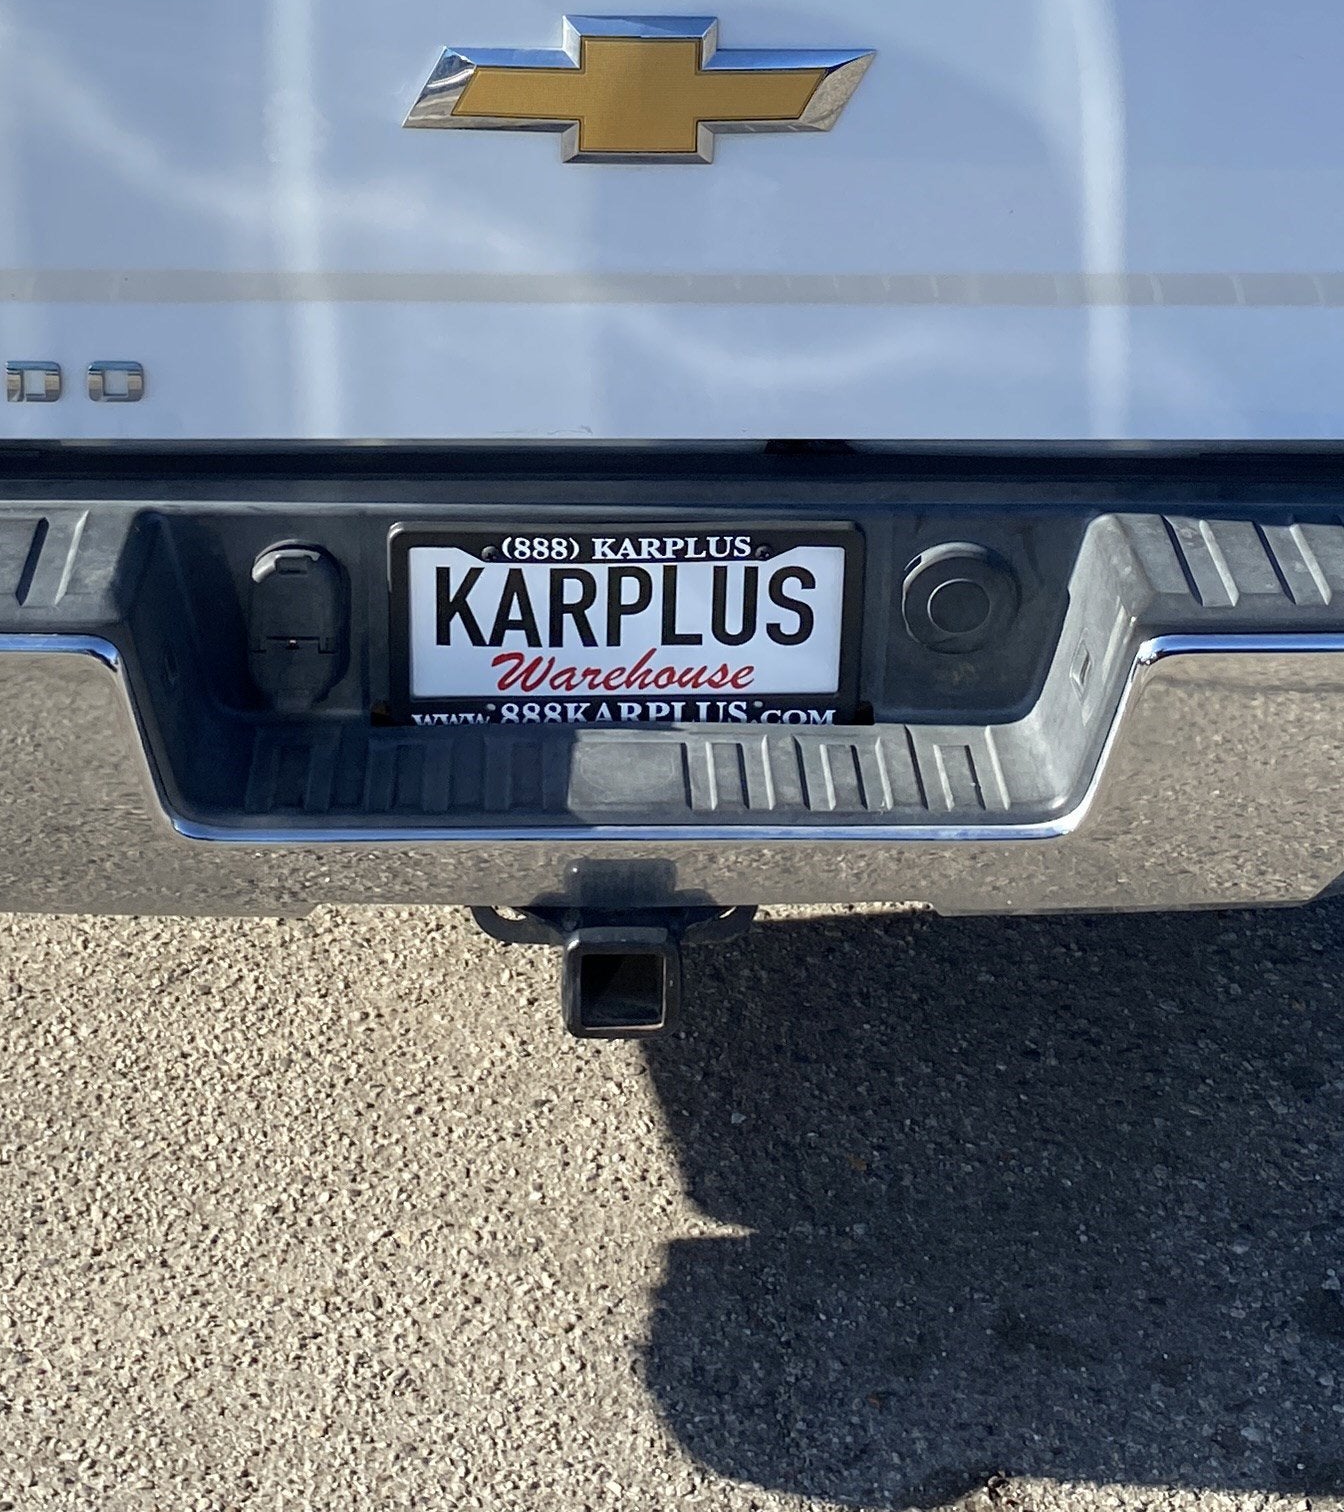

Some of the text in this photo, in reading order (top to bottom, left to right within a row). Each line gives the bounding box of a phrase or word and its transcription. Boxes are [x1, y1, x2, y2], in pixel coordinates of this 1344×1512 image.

[501, 535, 752, 561] (888) KARPLUS
[435, 565, 817, 649] KARPLUS
[491, 648, 756, 693] Warehouse
